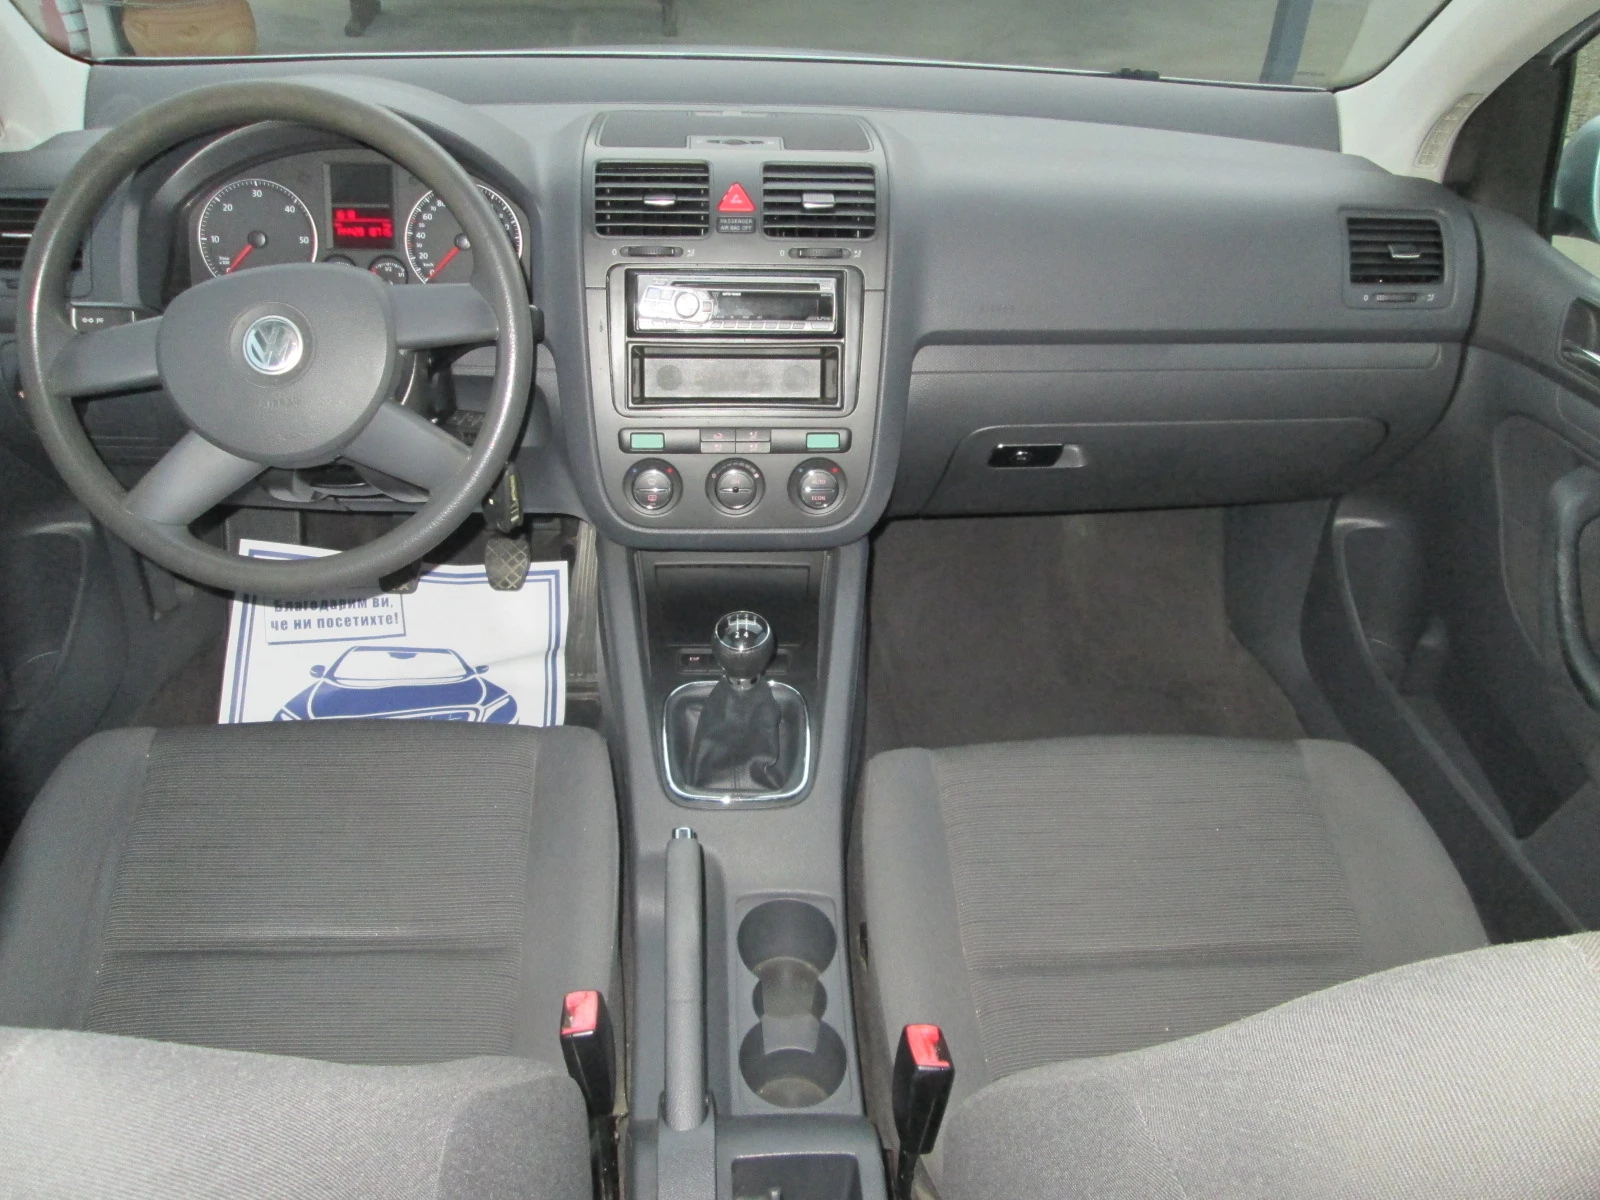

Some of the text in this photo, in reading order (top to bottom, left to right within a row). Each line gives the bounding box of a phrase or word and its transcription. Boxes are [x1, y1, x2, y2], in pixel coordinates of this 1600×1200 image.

[252, 190, 262, 198] 30
[223, 203, 233, 212] 20
[284, 205, 295, 213] 40
[423, 213, 433, 221] 60
[210, 235, 220, 243] 10
[299, 236, 309, 244] 50
[419, 252, 429, 260] 20
[274, 597, 367, 612] Благодарим
[270, 612, 399, 631] че ни посетихте!
